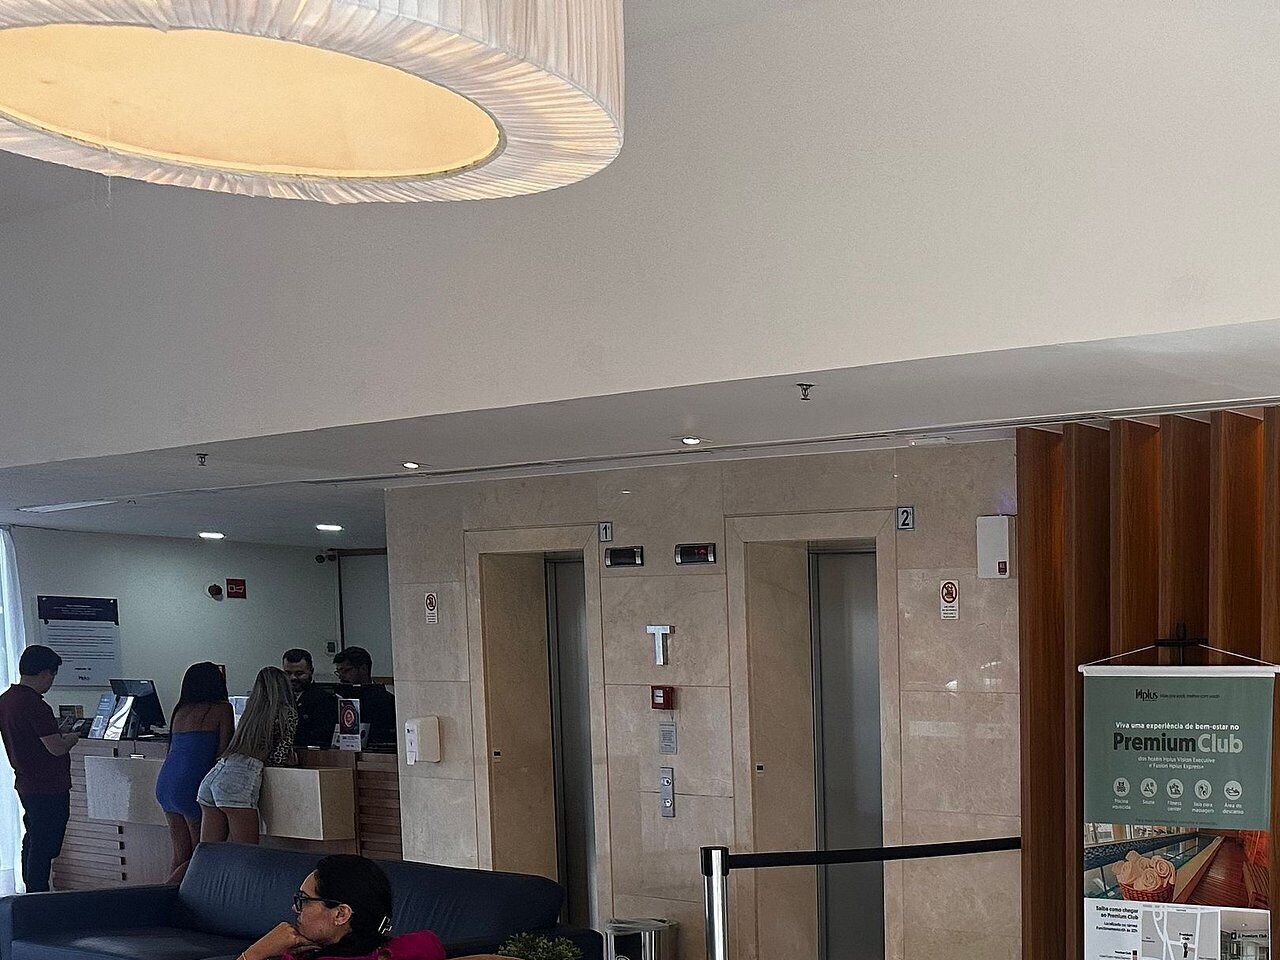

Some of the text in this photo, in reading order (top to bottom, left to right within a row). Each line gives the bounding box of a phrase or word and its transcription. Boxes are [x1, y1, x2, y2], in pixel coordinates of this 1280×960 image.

[901, 510, 910, 527] 2
[646, 625, 671, 666] T
[1146, 722, 1183, 731] experiência
